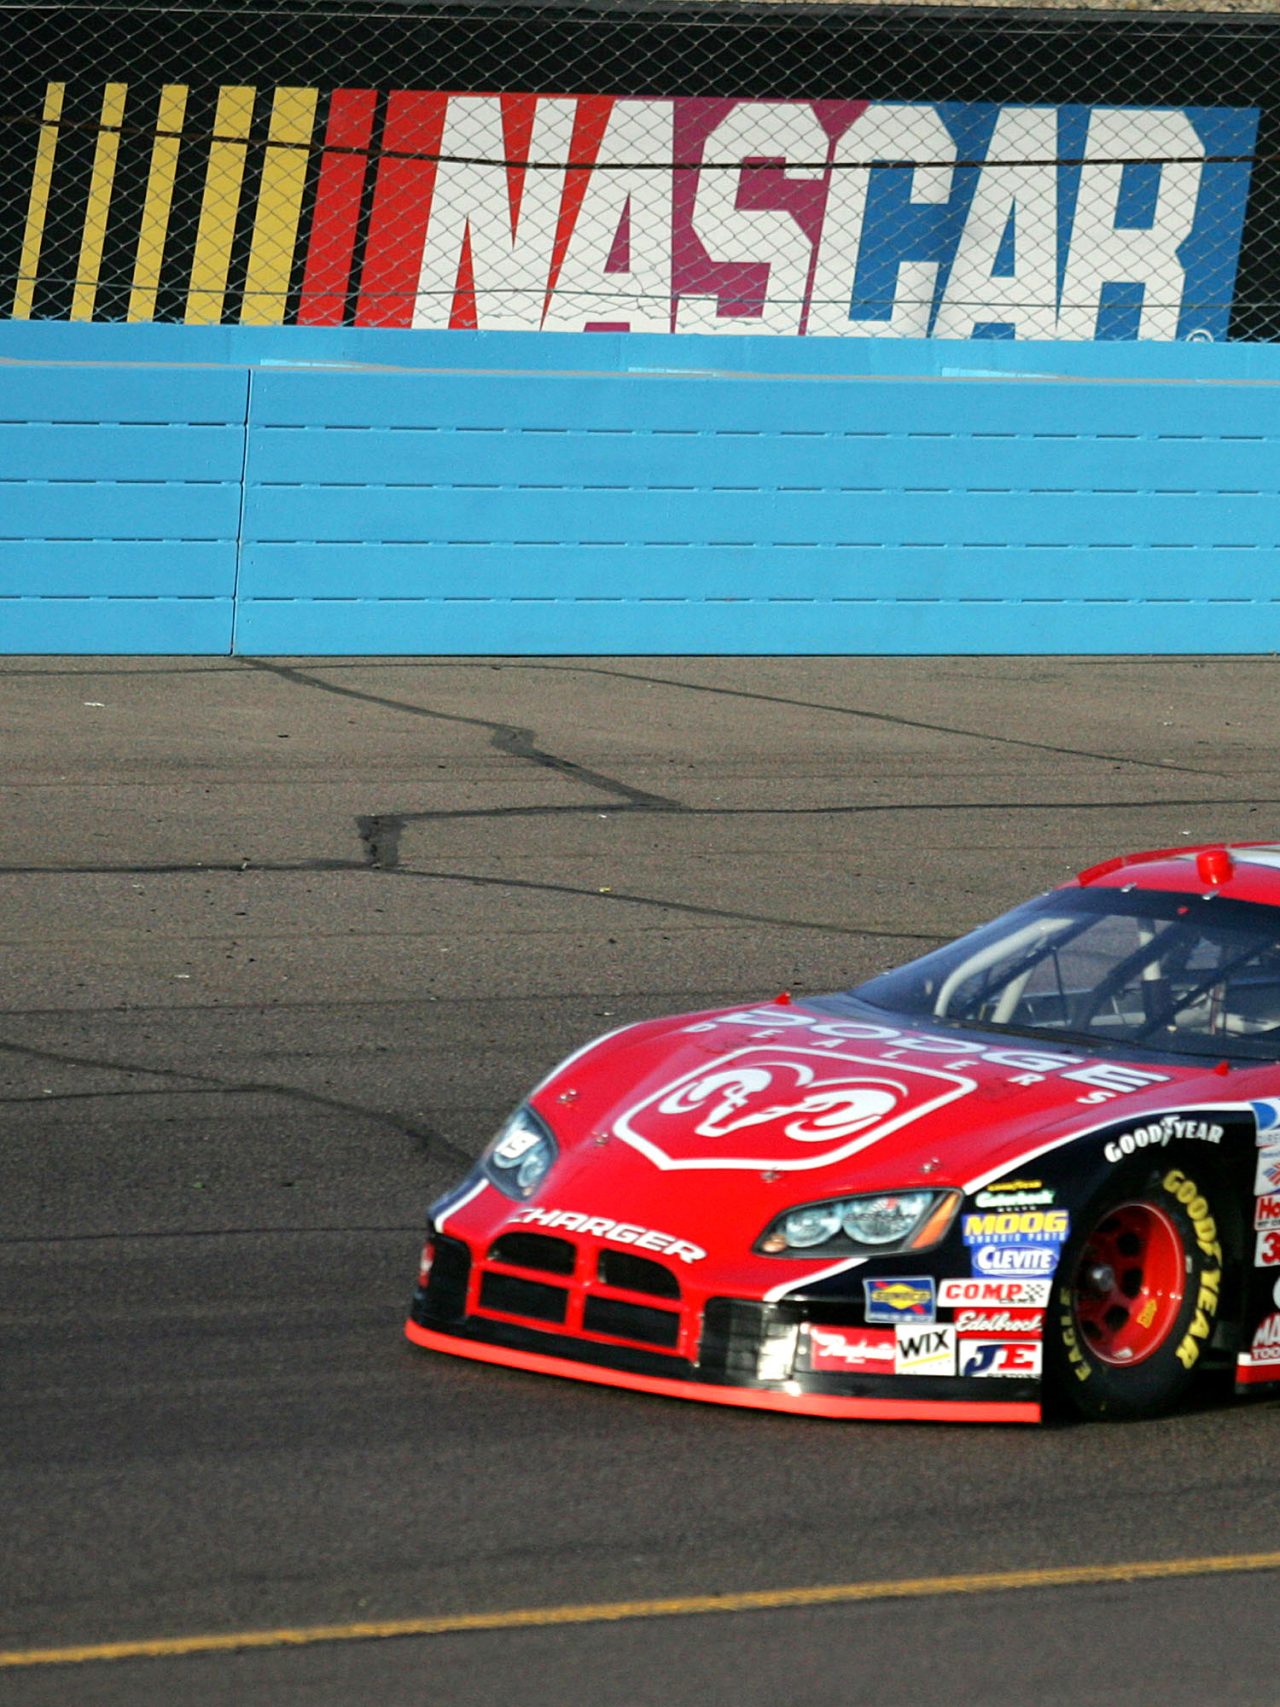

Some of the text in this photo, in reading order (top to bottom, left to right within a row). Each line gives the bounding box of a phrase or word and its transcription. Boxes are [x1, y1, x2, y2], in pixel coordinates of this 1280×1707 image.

[411, 96, 1206, 340] NASCAR
[714, 1008, 1172, 1094] DODGE
[1103, 1116, 1224, 1163] GOODYEAR
[506, 1208, 706, 1264] CHARGER
[965, 1210, 1069, 1236] MOOG
[945, 1283, 1023, 1300] COMP
[1162, 1168, 1223, 1370] GOODYEAR
[898, 1329, 949, 1358] WIX
